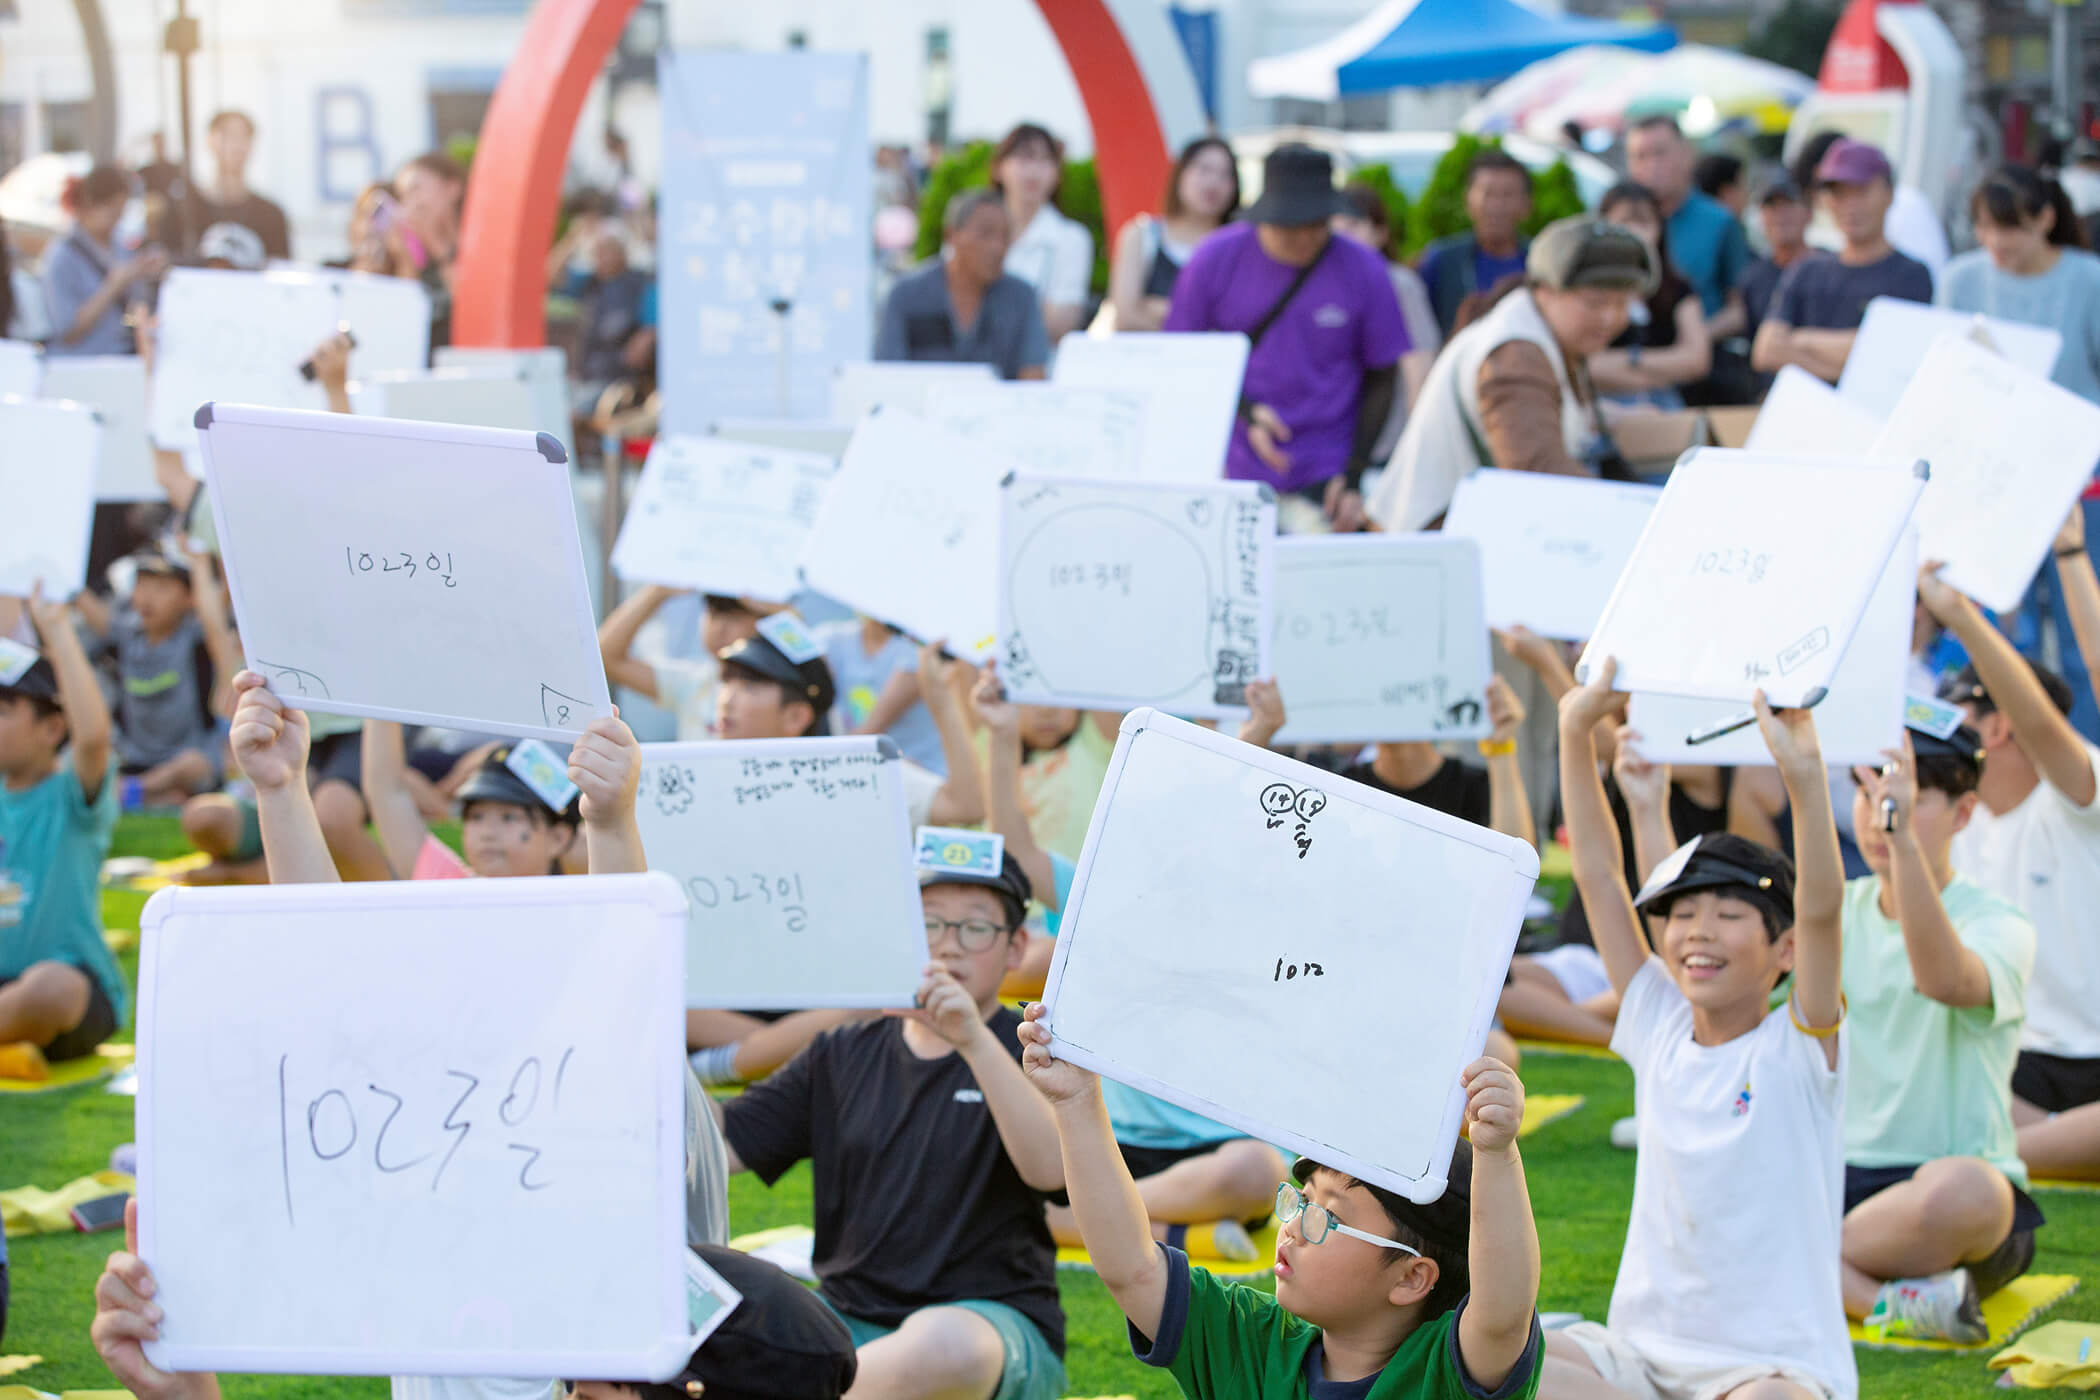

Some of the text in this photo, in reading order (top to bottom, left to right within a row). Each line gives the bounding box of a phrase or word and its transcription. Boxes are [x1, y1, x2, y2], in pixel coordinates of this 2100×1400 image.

[315, 86, 384, 203] B
[346, 545, 457, 588] 1023일
[556, 705, 571, 725] 8
[279, 1046, 574, 1228] 1023일
